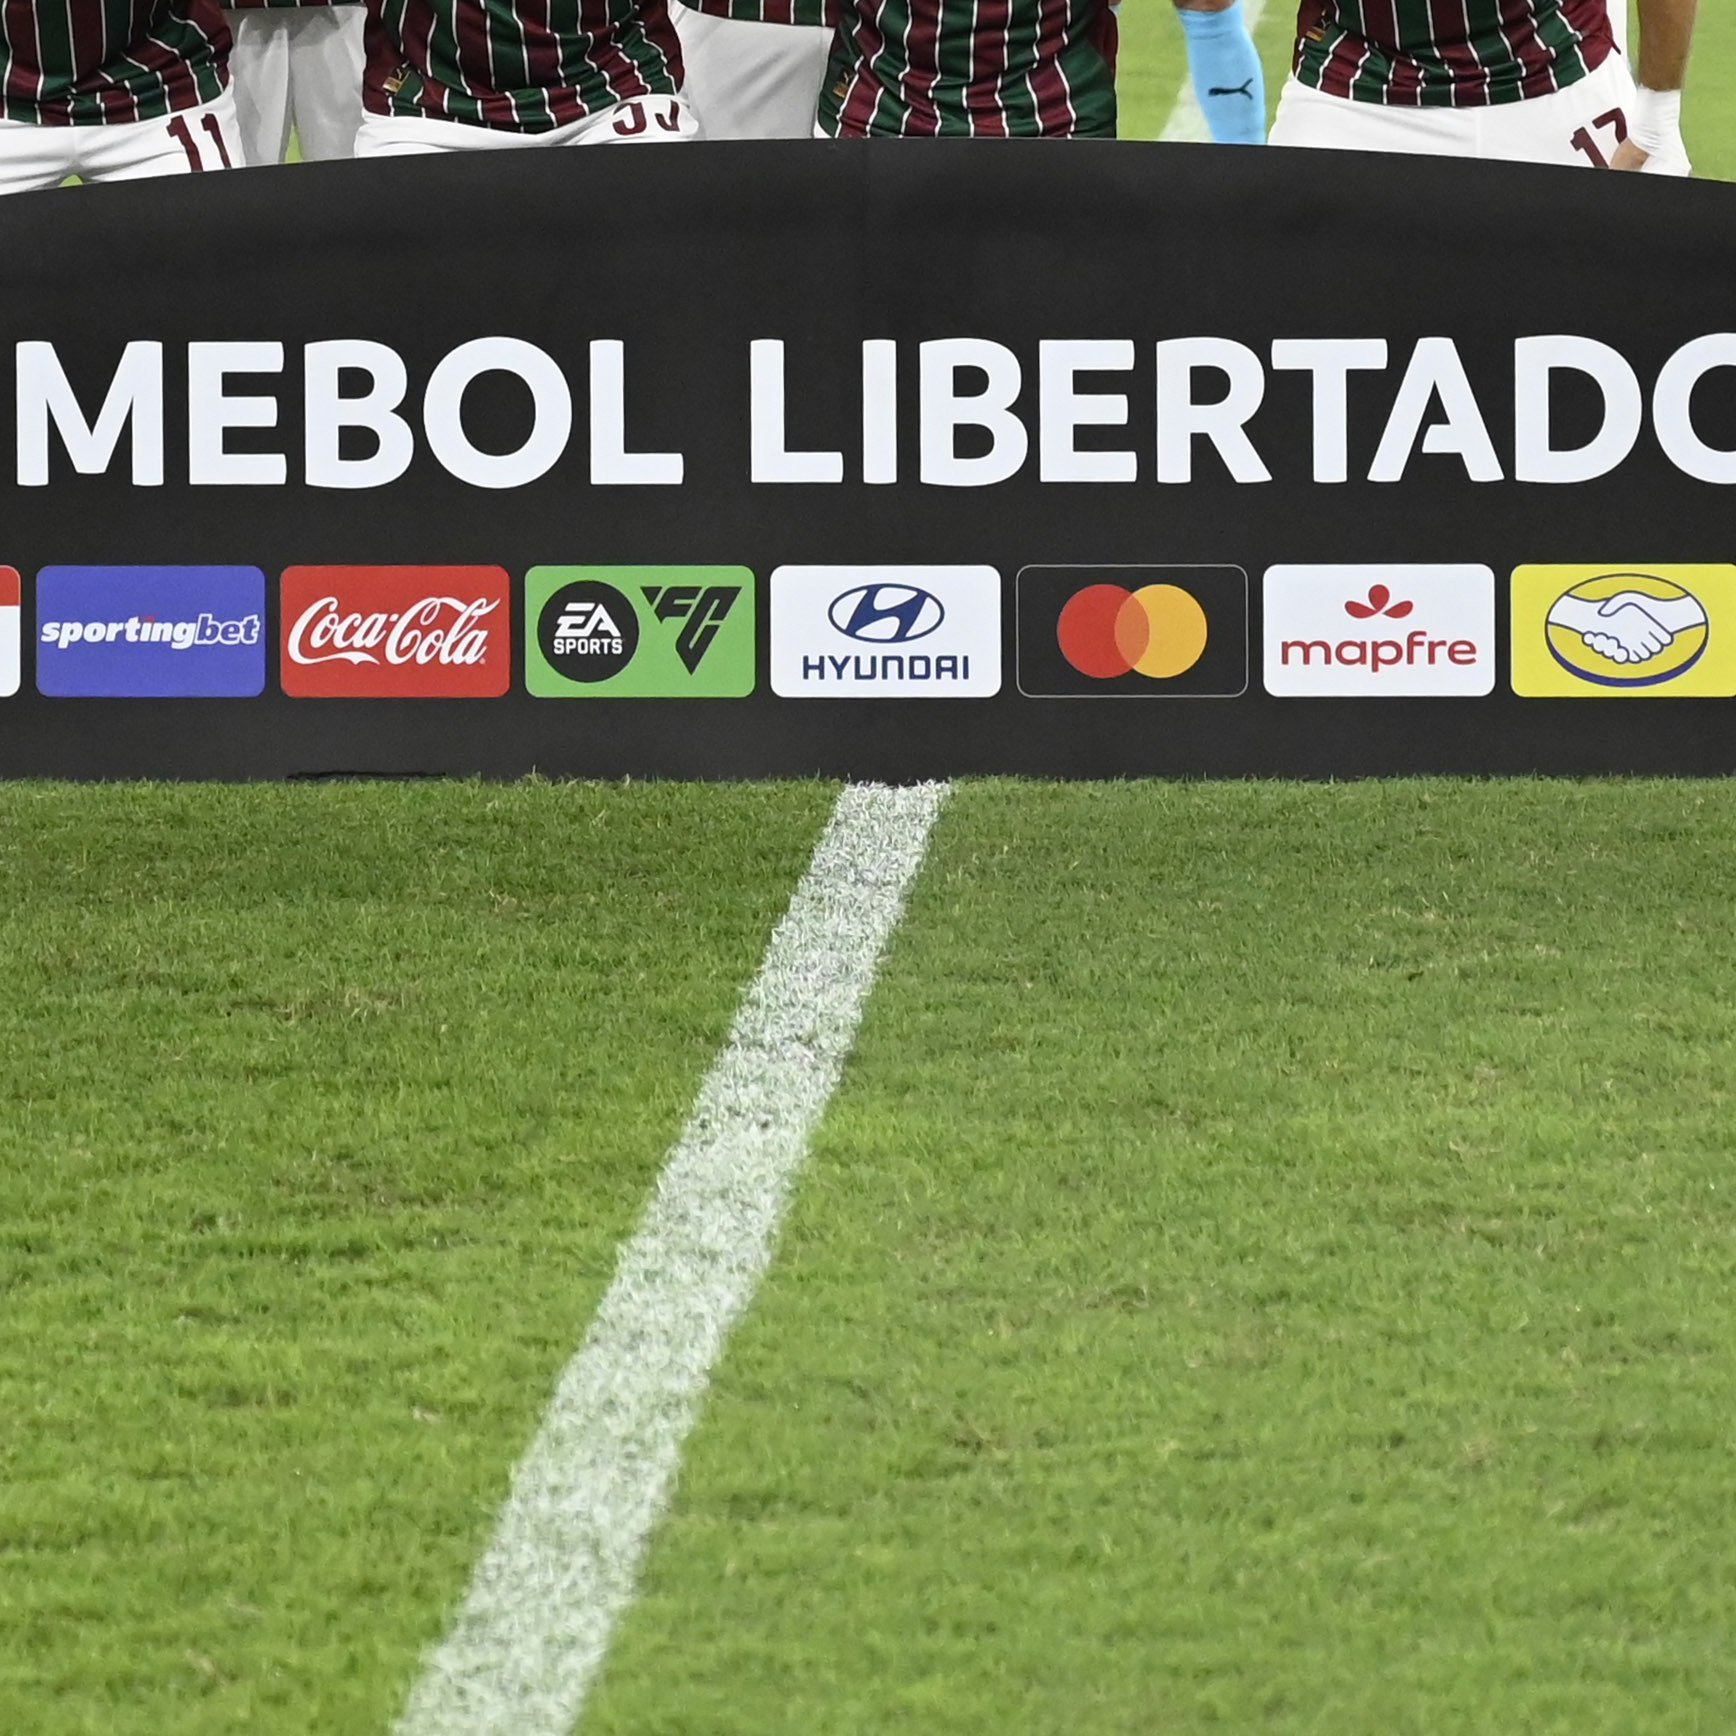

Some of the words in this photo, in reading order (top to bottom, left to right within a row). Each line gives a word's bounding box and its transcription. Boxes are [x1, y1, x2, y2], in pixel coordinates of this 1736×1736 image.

[166, 112, 232, 173] 11
[42, 615, 261, 650] sportingbet
[289, 598, 500, 665] Coca-Cola
[553, 638, 624, 656] SPORTS
[801, 655, 970, 681] HYUNDAI
[1281, 630, 1478, 674] mapfre
